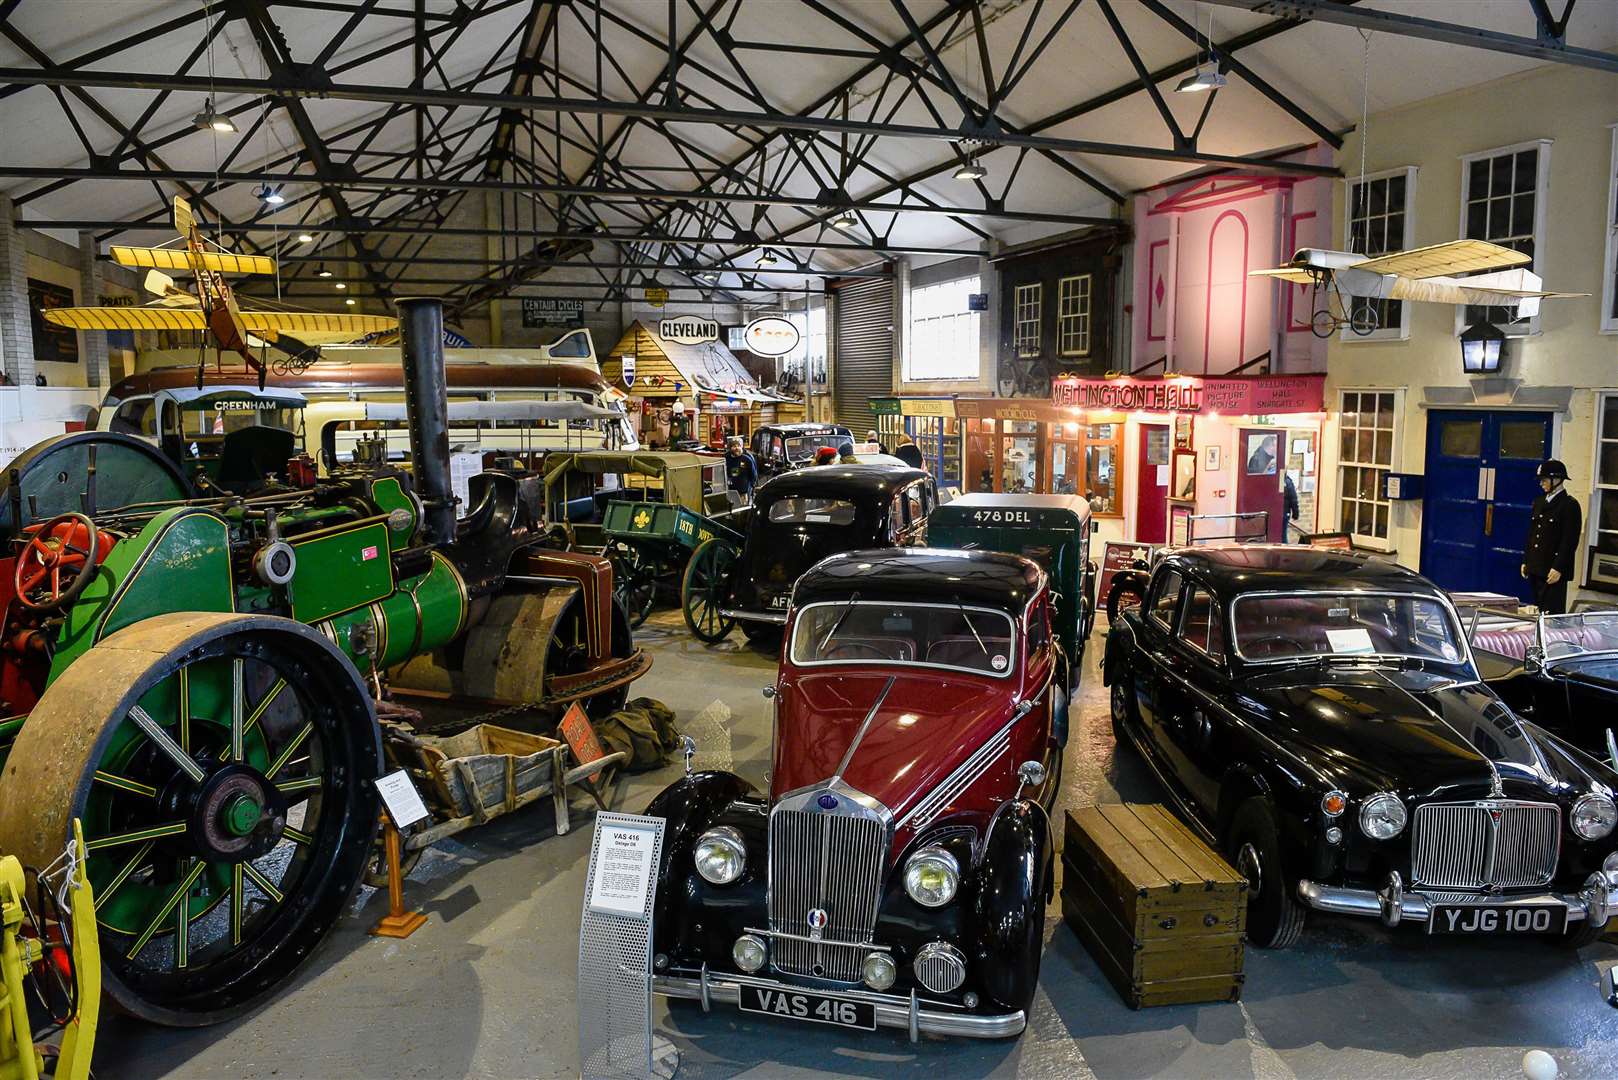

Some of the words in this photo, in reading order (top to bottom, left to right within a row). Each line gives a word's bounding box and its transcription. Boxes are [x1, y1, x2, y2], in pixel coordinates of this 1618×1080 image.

[524, 299, 556, 310] CENTAUR
[558, 300, 583, 310] CYCLES
[662, 322, 716, 337] CLEVELAND
[1206, 383, 1248, 391] ANIMATED
[1054, 384, 1147, 408] WELLINGTON
[1154, 384, 1201, 410] HALL
[1207, 391, 1246, 401] PICTURE
[214, 400, 276, 411] GREENHAM
[1210, 401, 1239, 409] HOUSE
[974, 511, 1002, 522] 478
[1005, 511, 1031, 523] DEL
[613, 832, 627, 841] VAS
[628, 834, 640, 842] 416
[1445, 909, 1499, 932] YJG
[1505, 909, 1551, 931] 100
[757, 990, 809, 1017] VAS
[815, 999, 857, 1024] 416
